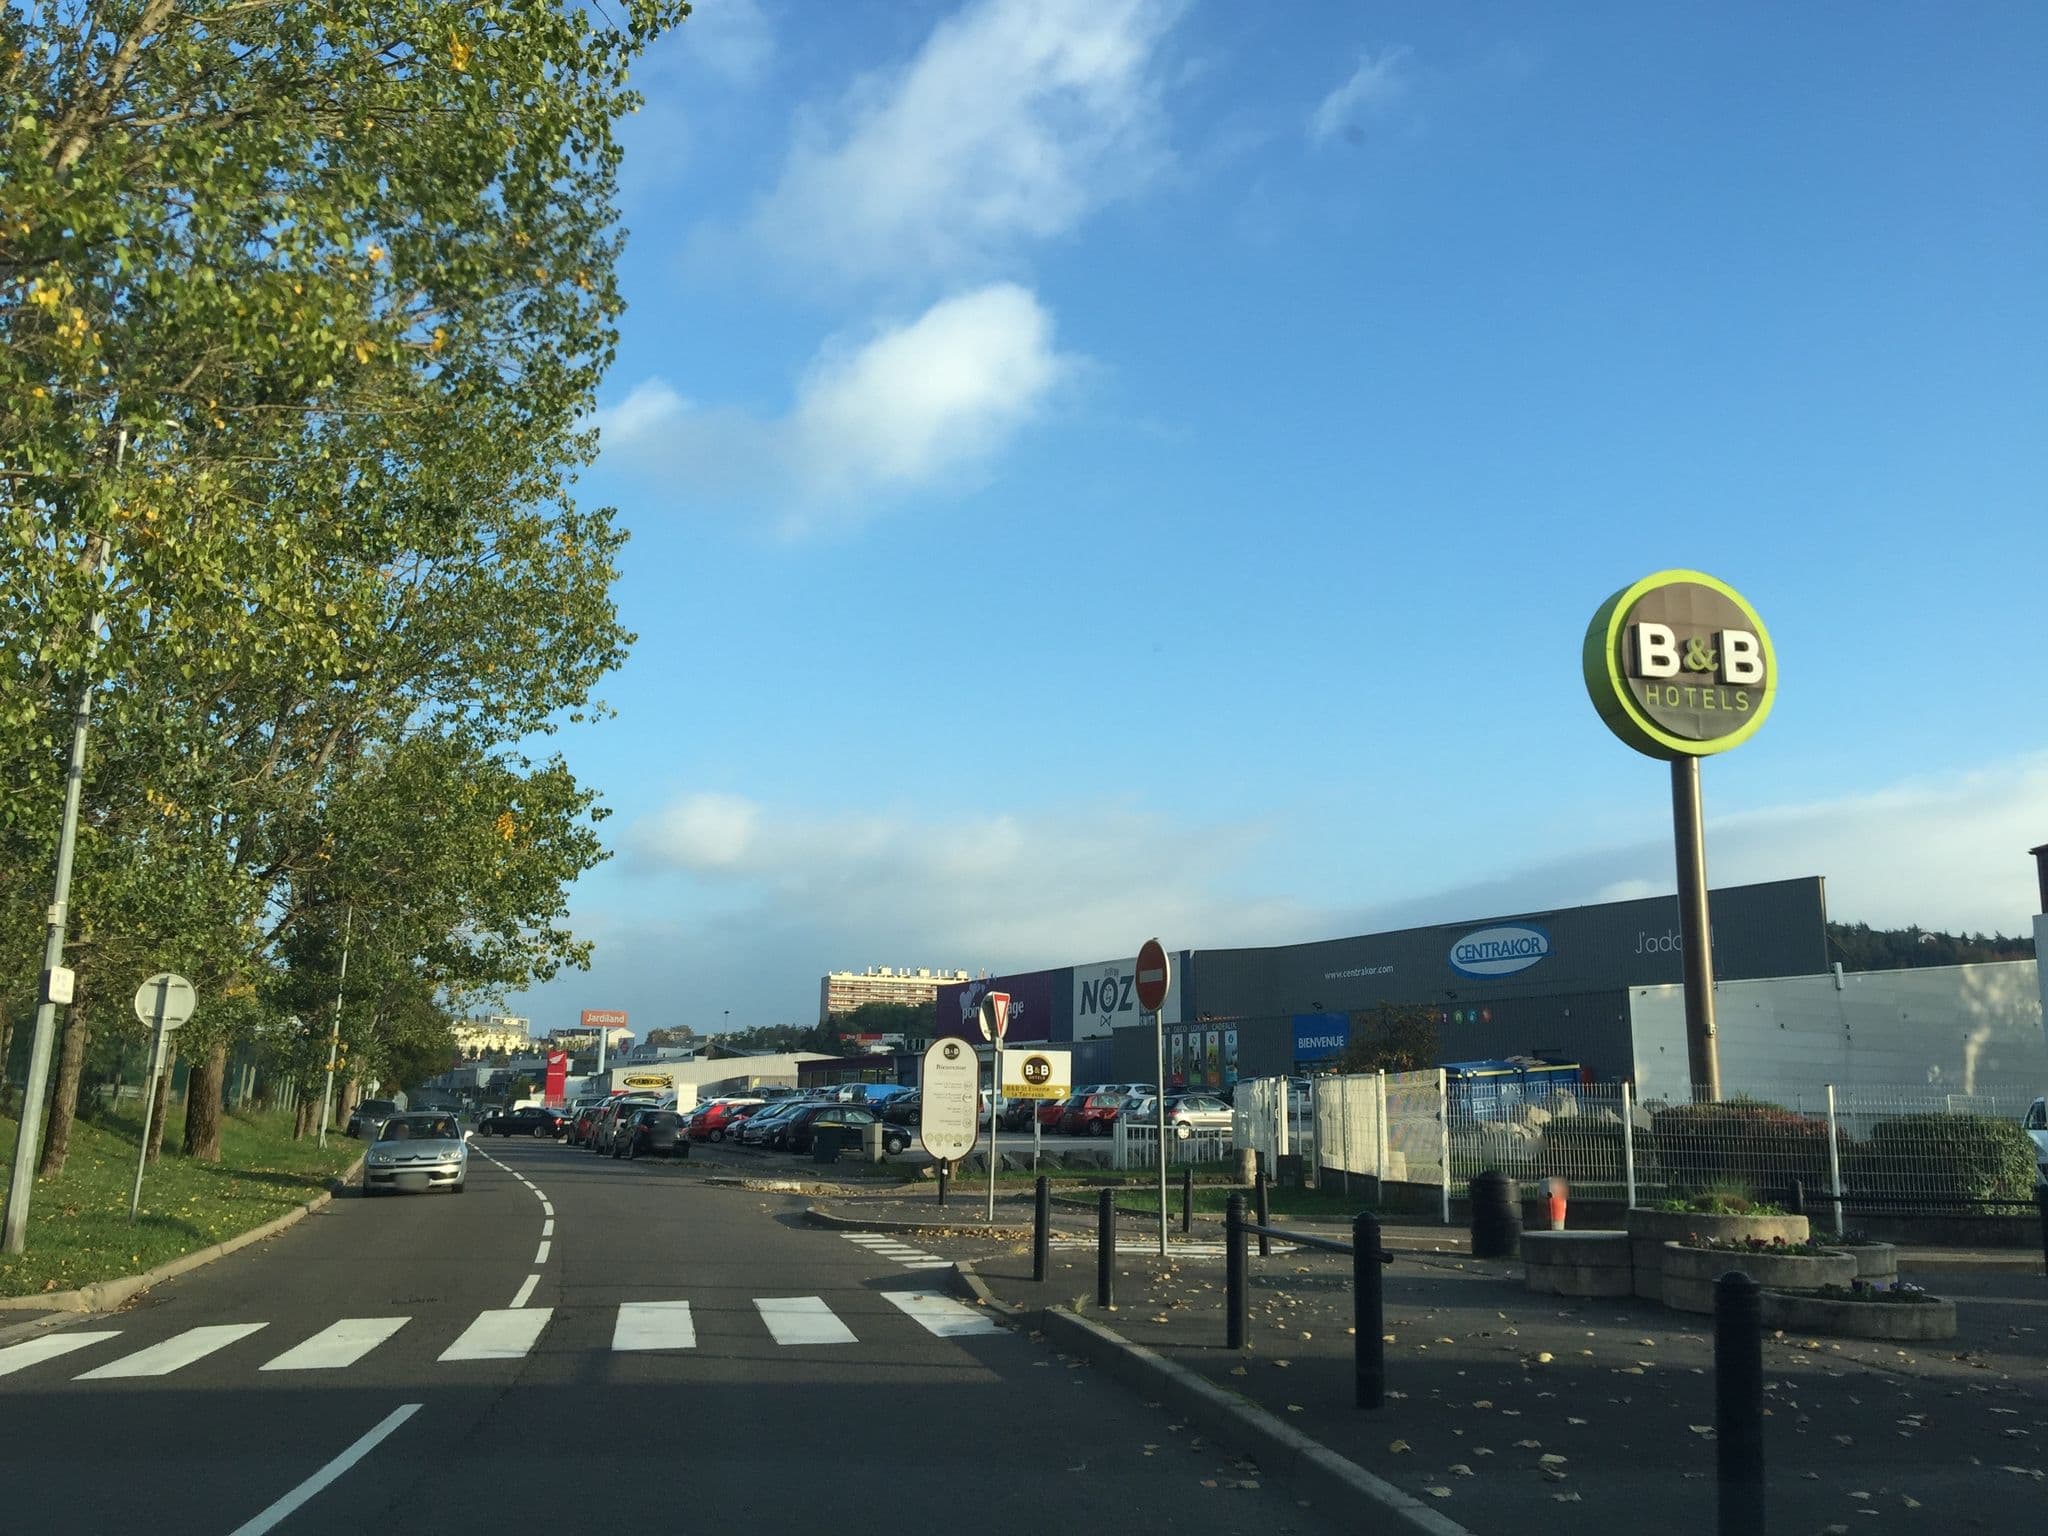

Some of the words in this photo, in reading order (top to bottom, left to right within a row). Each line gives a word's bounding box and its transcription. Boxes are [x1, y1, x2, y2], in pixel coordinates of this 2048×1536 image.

[1645, 684, 1750, 712] HOTELS
[1456, 937, 1541, 960] CENTRAKOR
[1324, 965, 1394, 980] www.centrakor.com
[1080, 975, 1134, 1015] NOZ
[587, 1013, 625, 1024] Jardiland
[1298, 1036, 1344, 1049] BIENVENUE
[1025, 1064, 1049, 1076] B&B
